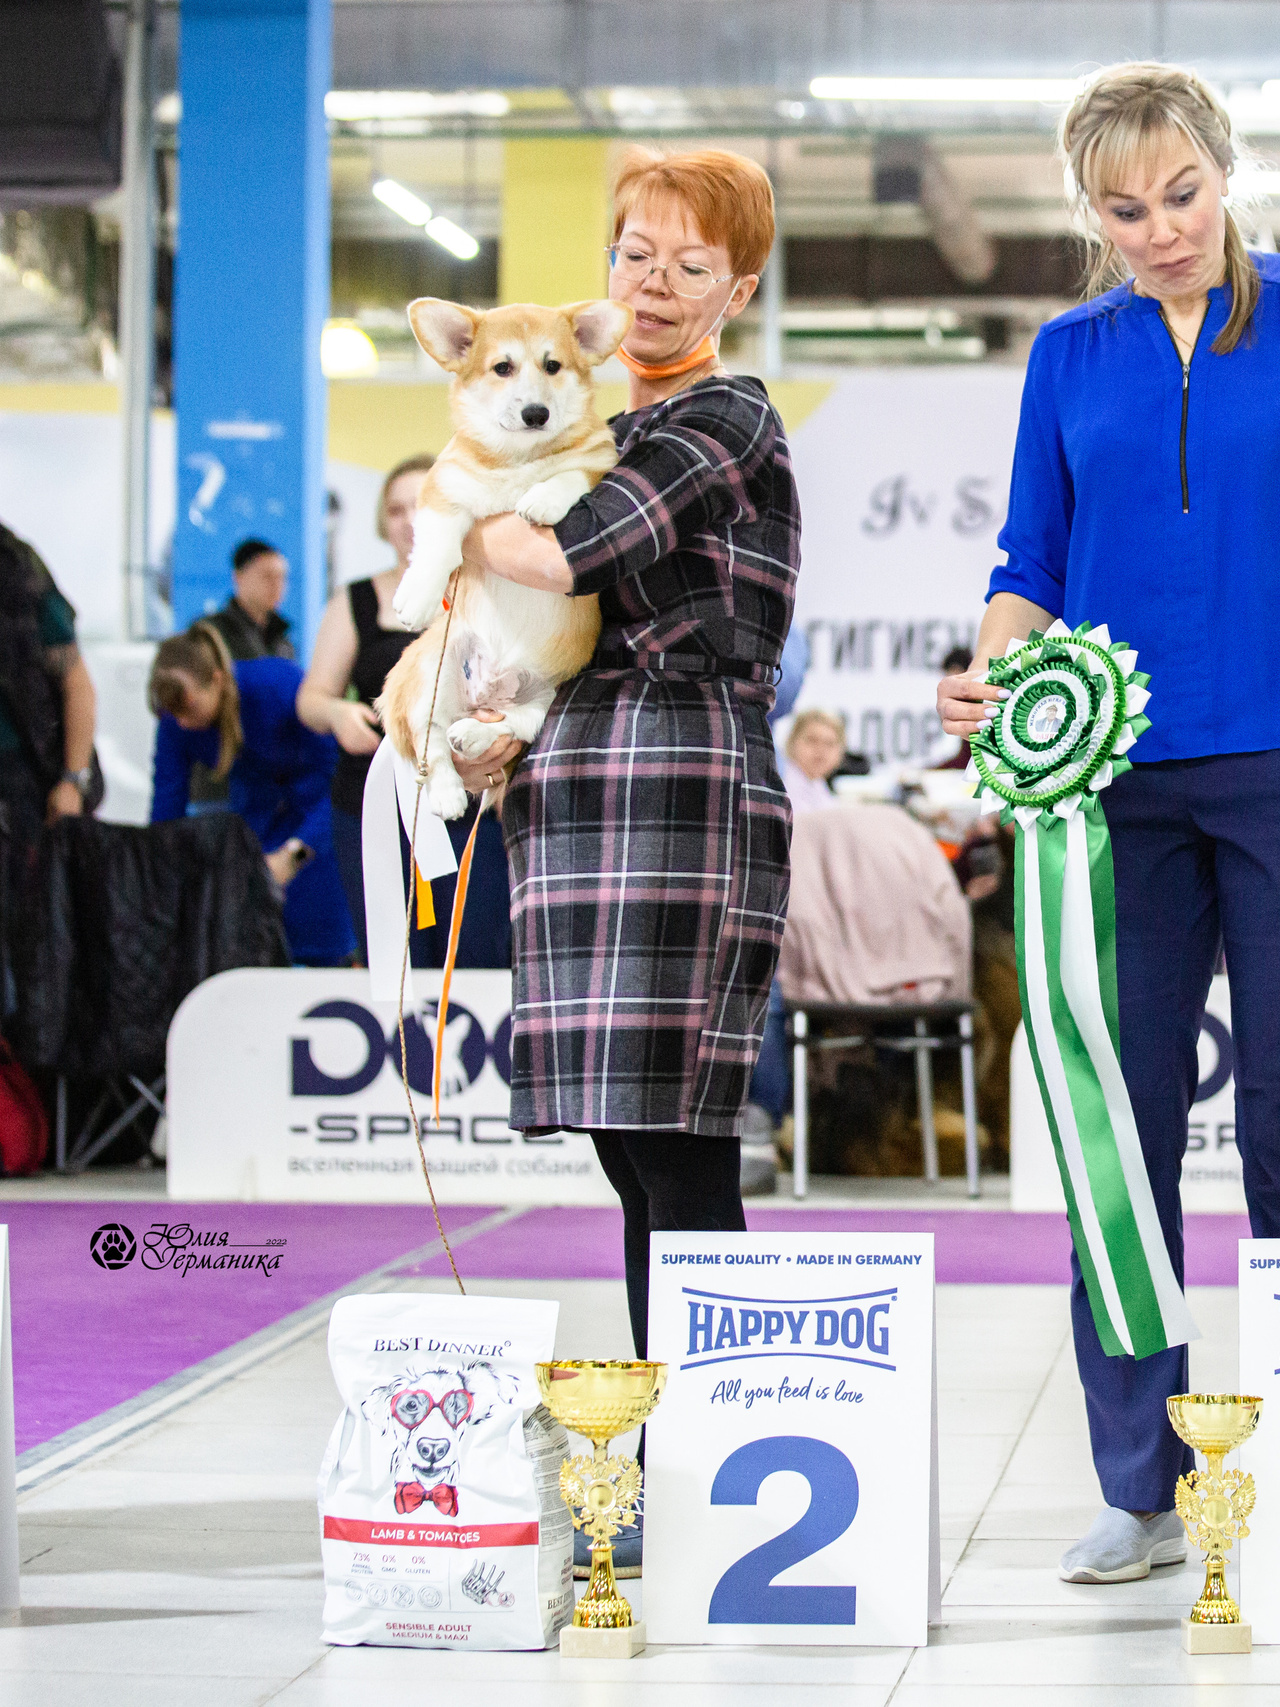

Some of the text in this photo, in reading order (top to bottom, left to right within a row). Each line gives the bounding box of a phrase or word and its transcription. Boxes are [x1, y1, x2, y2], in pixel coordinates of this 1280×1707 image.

[806, 618, 978, 672] ГИГИЕН
[289, 1000, 512, 1098] DO
[291, 1114, 563, 1144] -SPAC
[661, 1254, 922, 1266] SUPREME QUALITY MADE IN GERMANY
[687, 1301, 810, 1355] HAPPY
[374, 1337, 423, 1352] BEST
[710, 1377, 864, 1409] All you feed is love
[371, 1528, 480, 1543] LAMB & TOMATOES
[708, 1436, 859, 1625] 2
[353, 1552, 370, 1562] 73%
[382, 1554, 396, 1563] 0%
[411, 1556, 425, 1564] 0%
[386, 1622, 472, 1632] SENSIBLE ADULT
[392, 1631, 433, 1639] MEDIUM
